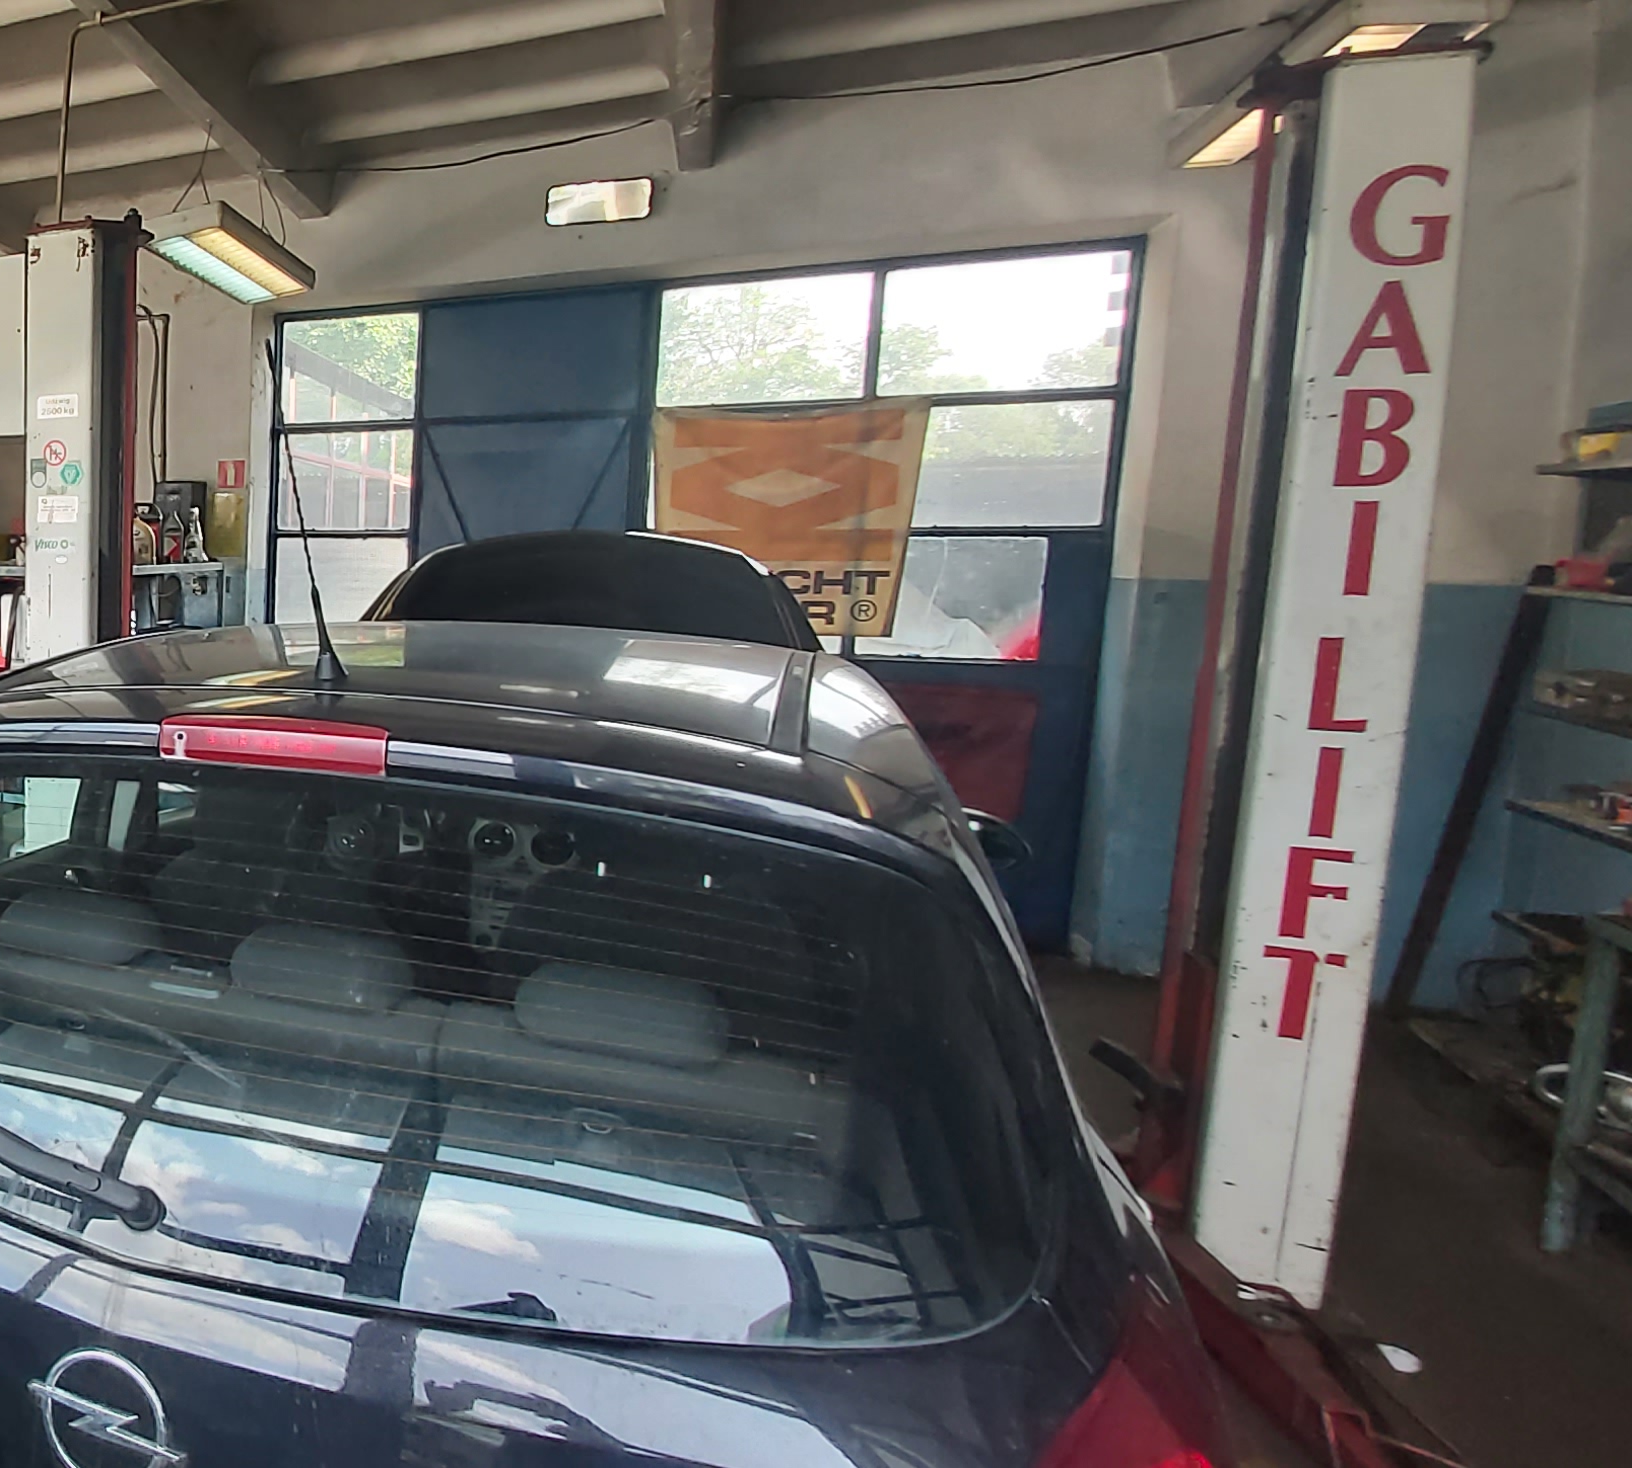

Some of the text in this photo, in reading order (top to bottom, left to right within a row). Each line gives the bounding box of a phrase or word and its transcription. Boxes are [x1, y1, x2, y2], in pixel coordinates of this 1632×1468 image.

[41, 406, 74, 415] 2500 kg
[777, 570, 890, 595] CHT
[1263, 164, 1450, 1040] GABI LIFT
